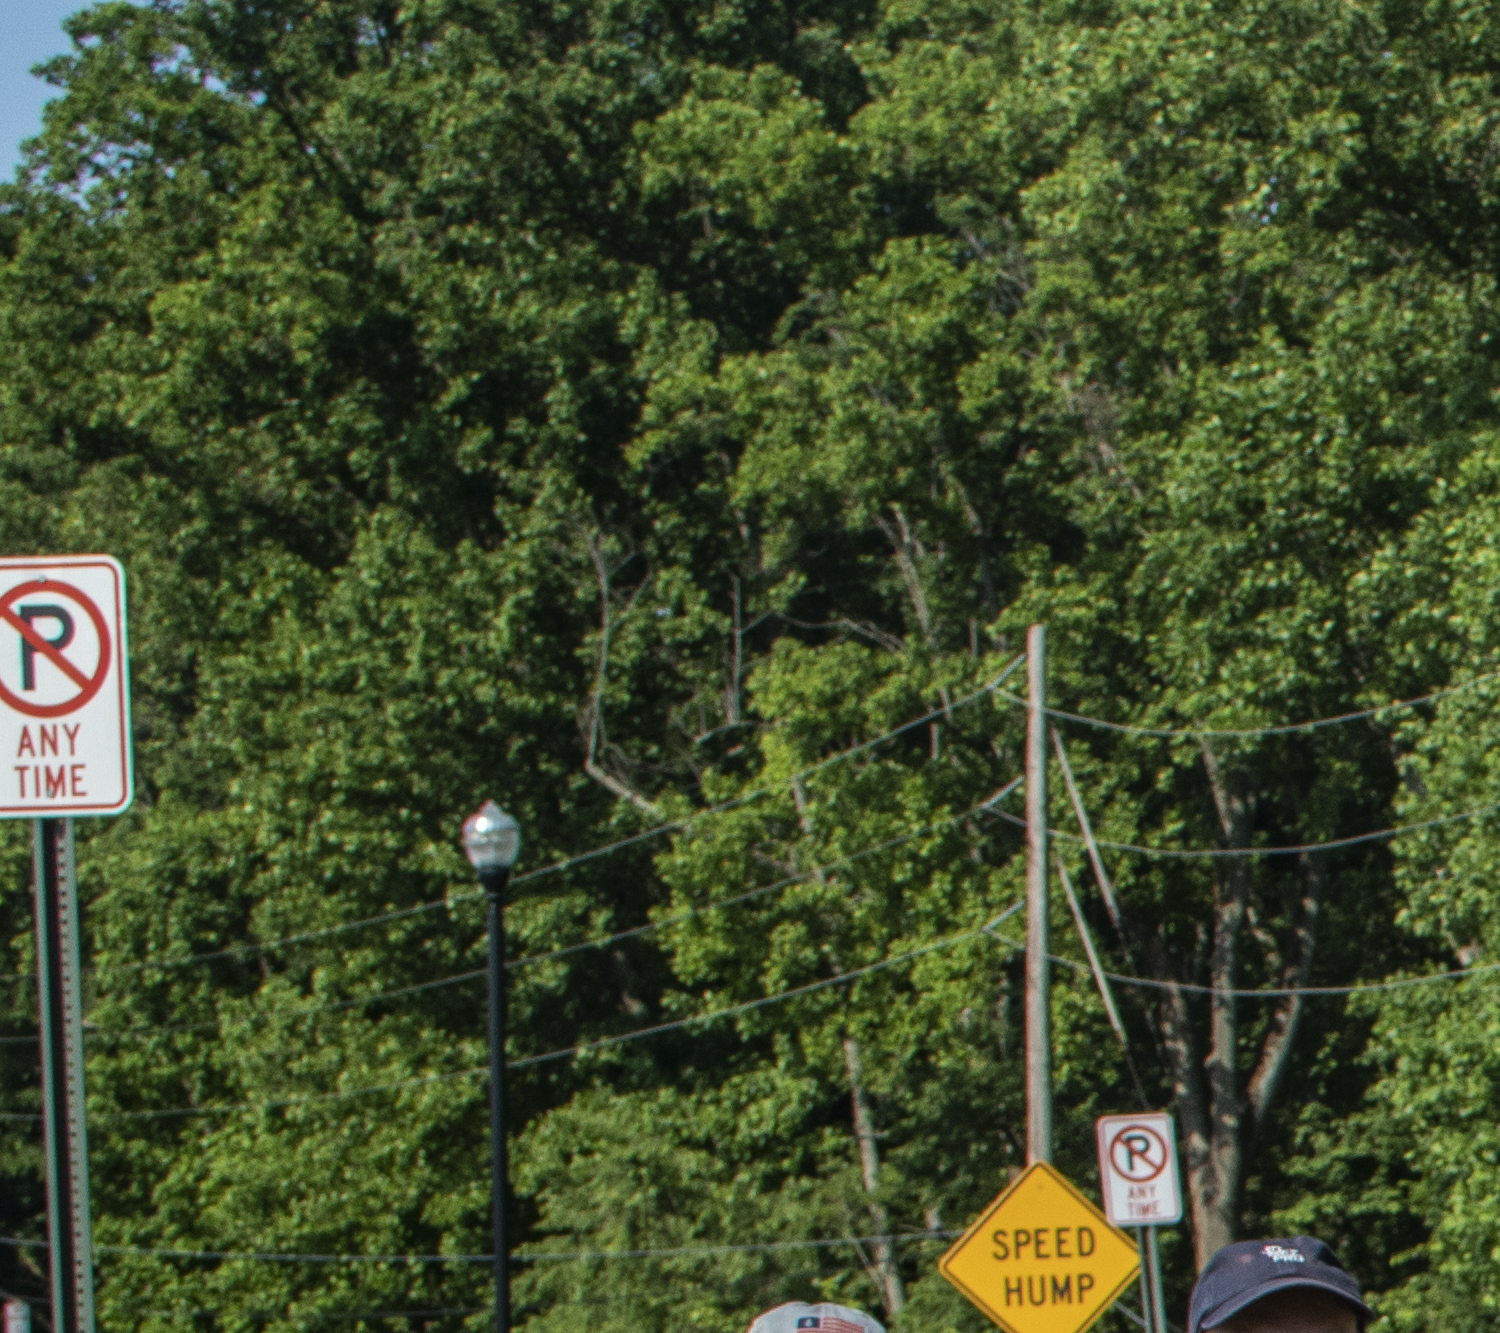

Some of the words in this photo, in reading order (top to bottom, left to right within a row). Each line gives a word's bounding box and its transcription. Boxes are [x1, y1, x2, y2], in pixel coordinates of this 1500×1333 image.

[17, 723, 82, 758] ANY
[14, 763, 88, 798] TIME
[992, 1226, 1095, 1261] SPEED
[1004, 1275, 1095, 1307] HUMP
